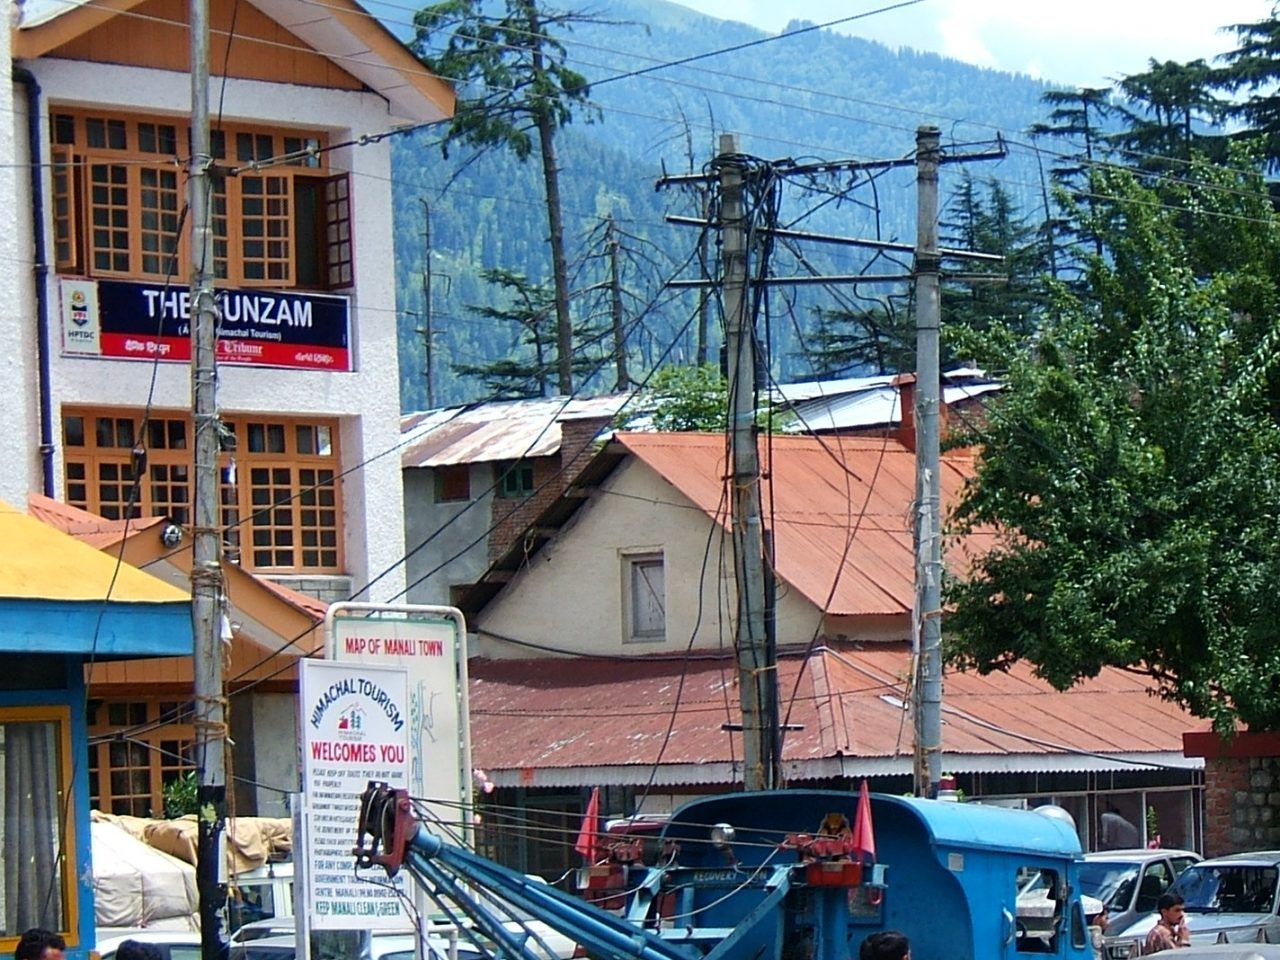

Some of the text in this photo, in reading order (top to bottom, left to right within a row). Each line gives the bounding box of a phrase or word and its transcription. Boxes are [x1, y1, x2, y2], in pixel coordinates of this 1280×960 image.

[142, 289, 313, 328] THE UNZAM
[250, 329, 282, 342] Tourism)
[345, 637, 443, 657] MAP OF MANALI TOWN
[310, 678, 405, 732] HIMACHAL TOURISM
[311, 741, 405, 763] WELCOMES YOU
[693, 870, 737, 881] RECOVERY
